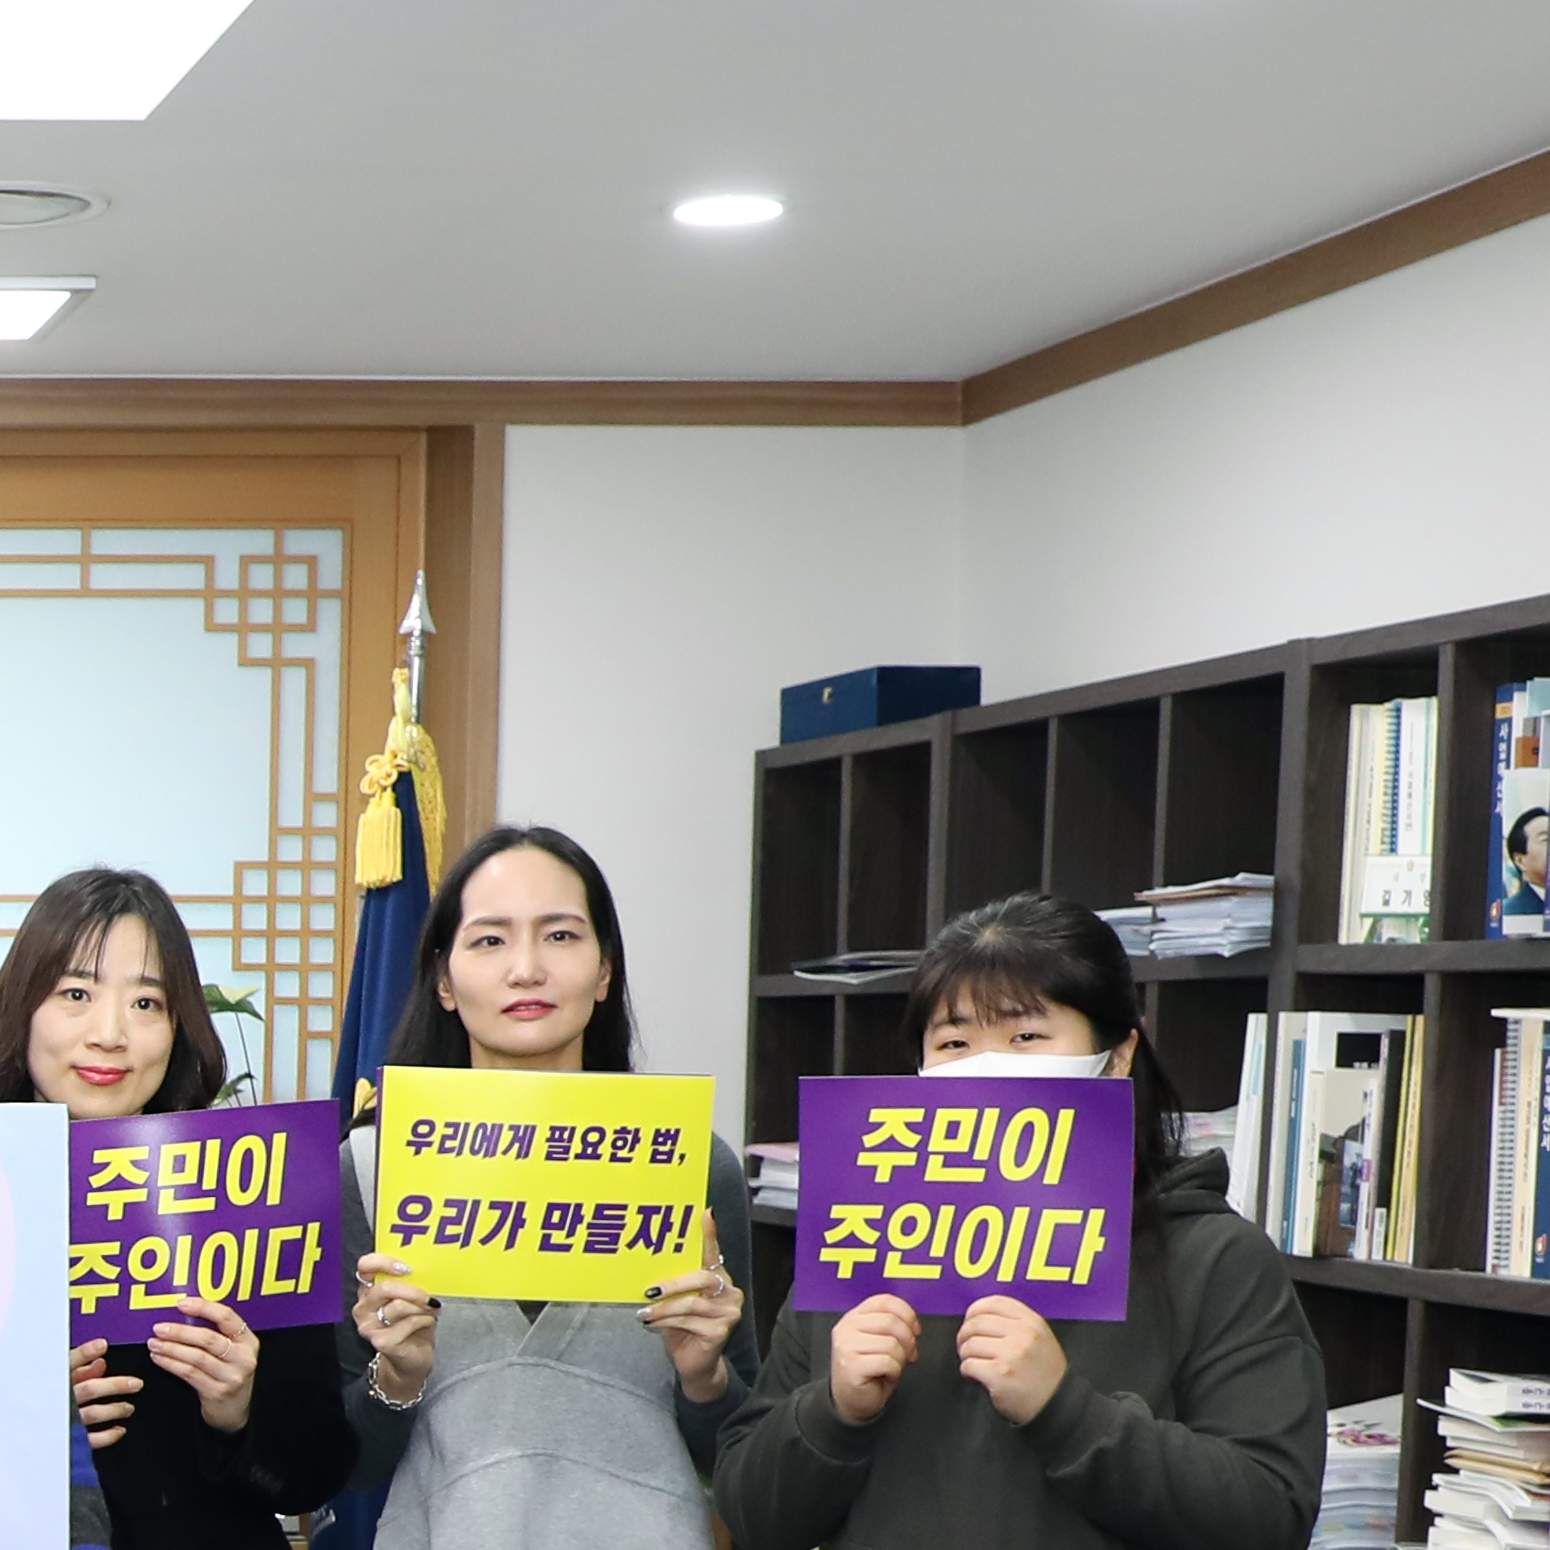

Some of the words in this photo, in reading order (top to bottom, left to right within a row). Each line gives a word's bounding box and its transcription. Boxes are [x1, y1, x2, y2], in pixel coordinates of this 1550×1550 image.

[85, 1130, 289, 1222] 주민이
[405, 1118, 534, 1159] 우리에게
[544, 1124, 641, 1165] 필요한
[649, 1127, 689, 1166] 법,
[856, 1106, 1075, 1186] 주민이
[389, 1194, 527, 1252] 우리가
[540, 1201, 695, 1256] 만들자!
[818, 1201, 1107, 1285] 주인이다
[69, 1222, 323, 1316] 주인이다
